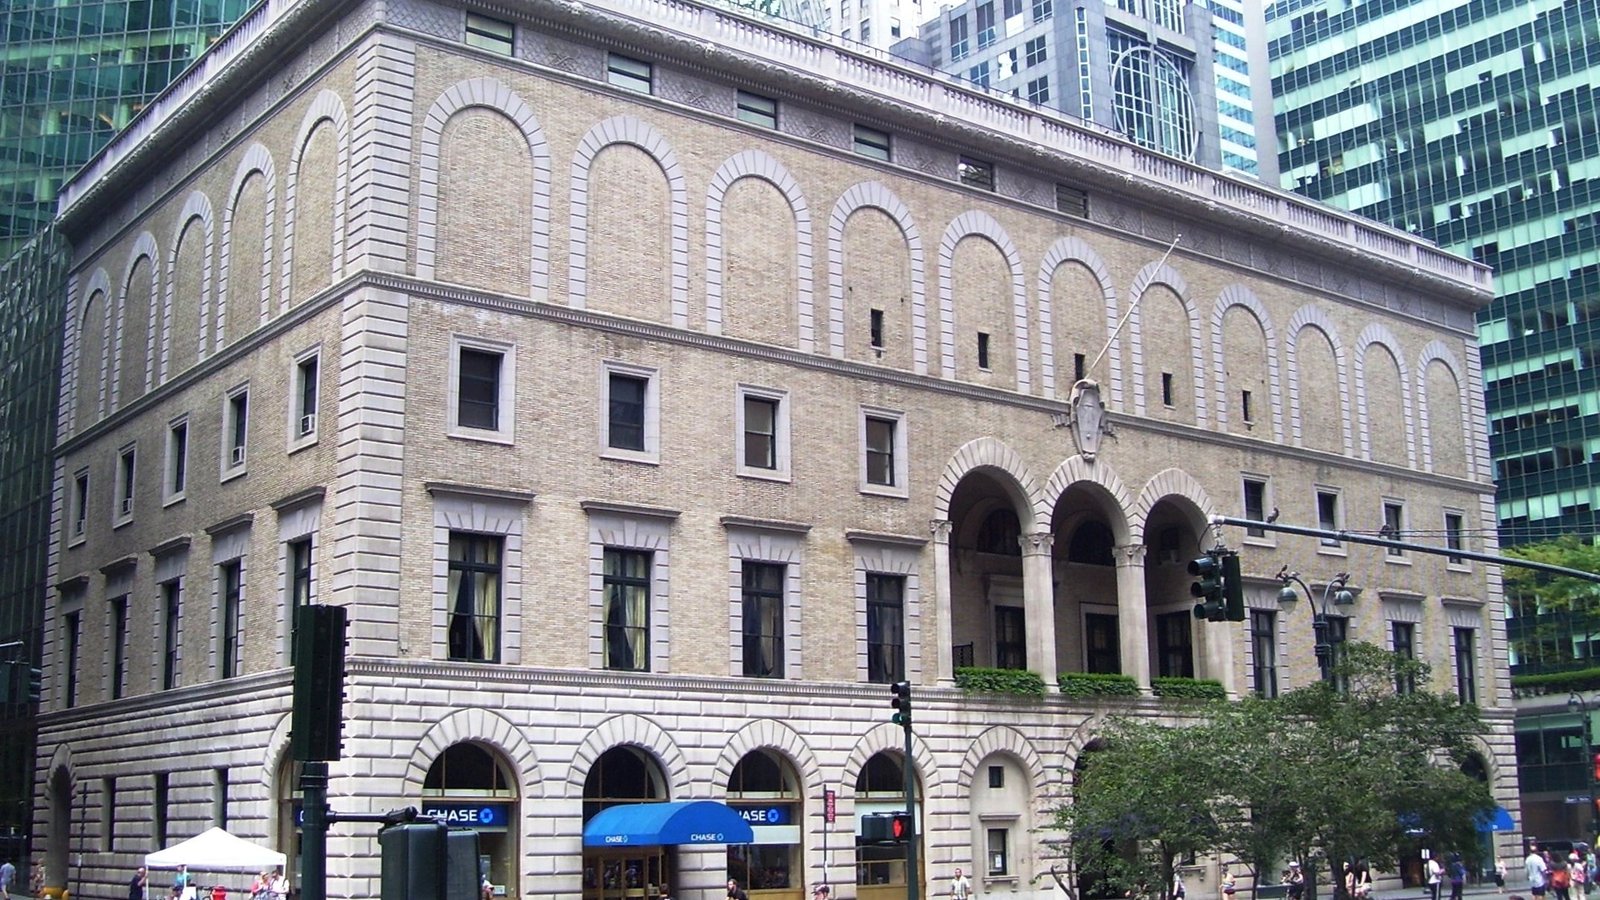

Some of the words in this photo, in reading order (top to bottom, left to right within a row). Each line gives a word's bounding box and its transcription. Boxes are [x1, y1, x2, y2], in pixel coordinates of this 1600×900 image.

[427, 809, 478, 821] CHASE
[739, 810, 766, 821] ASE
[690, 833, 716, 841] CHASE
